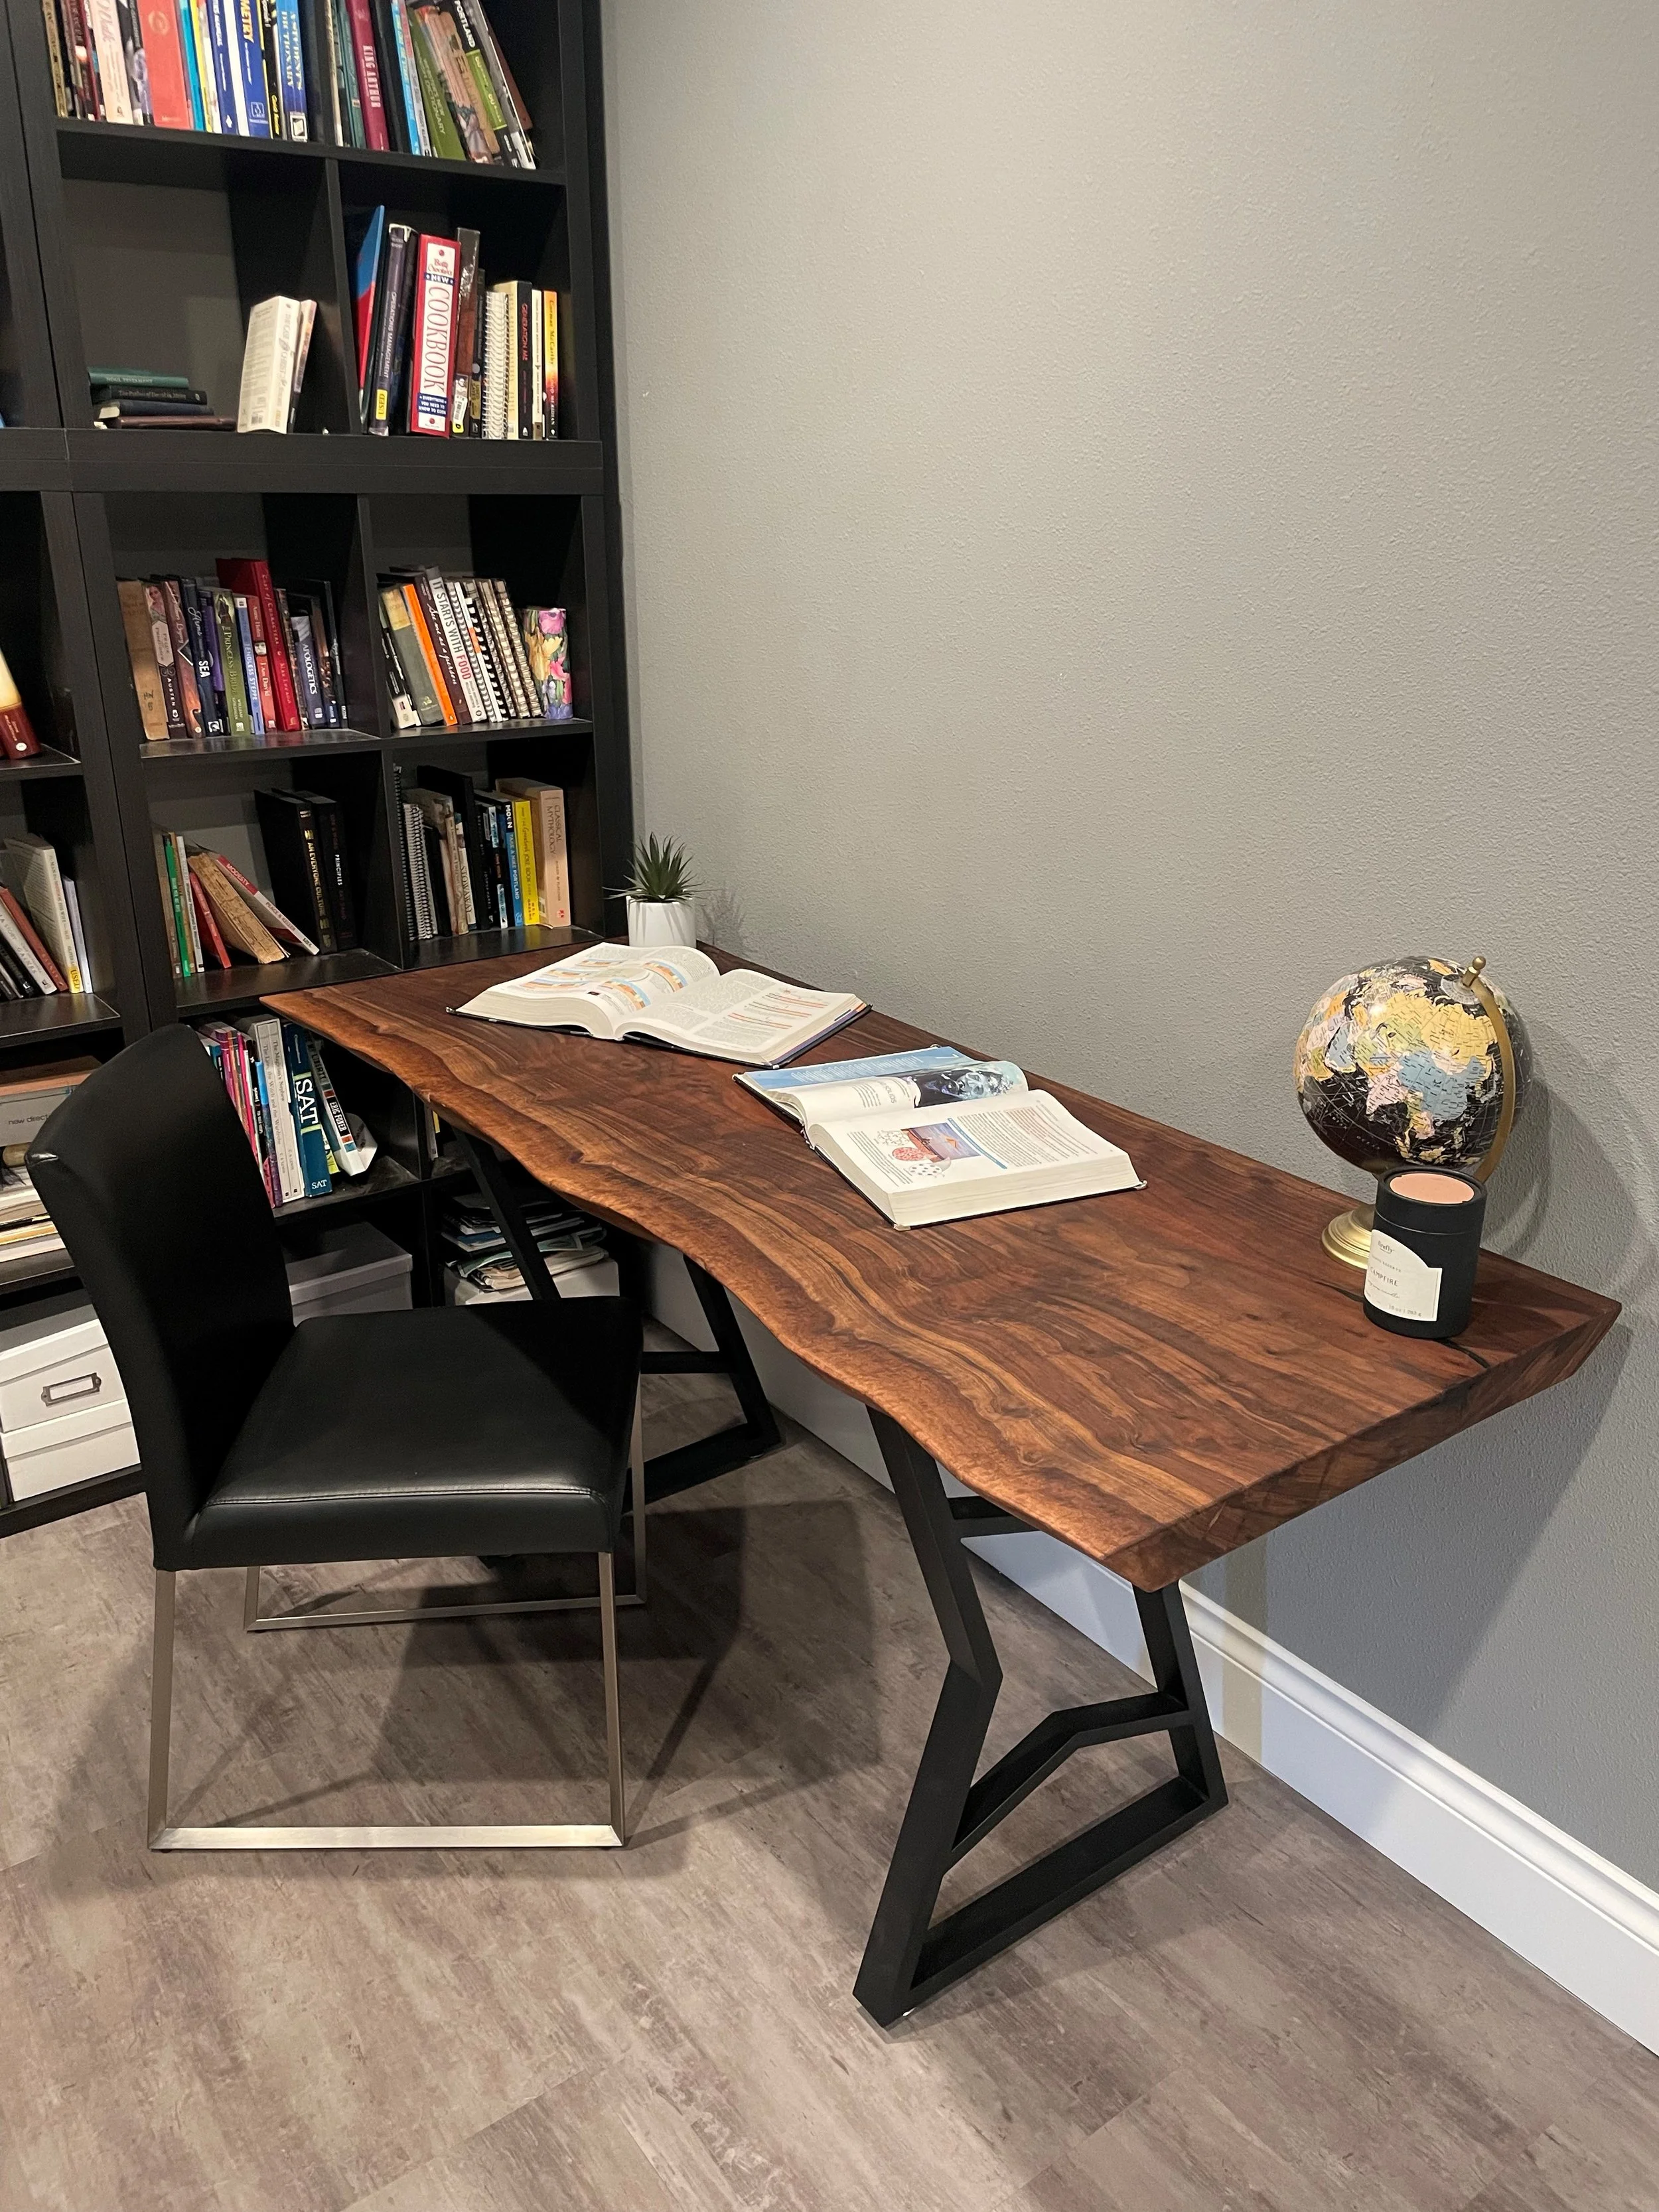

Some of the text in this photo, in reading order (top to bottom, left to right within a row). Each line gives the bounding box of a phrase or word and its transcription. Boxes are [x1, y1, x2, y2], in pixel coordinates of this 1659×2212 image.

[454, 1, 476, 47] PORTLAND
[362, 45, 376, 67] KING
[365, 70, 382, 107] ARTHUR
[423, 79, 446, 134] DICTIONARY
[431, 274, 449, 284] NEW
[388, 291, 396, 331] OPERATIONS
[423, 286, 450, 392] COOKBOOK
[383, 332, 392, 378] MANAGEMENT
[427, 602, 439, 619] See
[432, 581, 472, 680] IT STARTS WITH FOOD
[433, 621, 440, 634] me
[438, 636, 444, 645] as
[223, 632, 235, 668] PRINCESS
[245, 647, 253, 675] ENDLESS
[198, 660, 210, 677] SEA
[302, 643, 317, 694] APOLOGETICS
[439, 653, 457, 685] person
[167, 677, 176, 706] AUSTEN
[546, 806, 555, 854] MYTHOLOGY
[225, 862, 250, 887] MODESTY
[307, 842, 325, 916] AN EVERYONE CULTURE
[460, 865, 472, 913] STOWAWAY
[265, 901, 278, 915] PEACE
[16, 946, 36, 974] GAINES
[70, 969, 80, 988] USED
[273, 1051, 282, 1079] Magician's
[310, 1054, 326, 1079] LIBERTY
[293, 1079, 319, 1125] SAT
[328, 1102, 347, 1130] ERIC FONER
[273, 1119, 282, 1144] Wardrobe
[311, 1179, 328, 1189] SAT
[1378, 1240, 1394, 1254] firefly
[1370, 1266, 1399, 1287] CAMPFIRE
